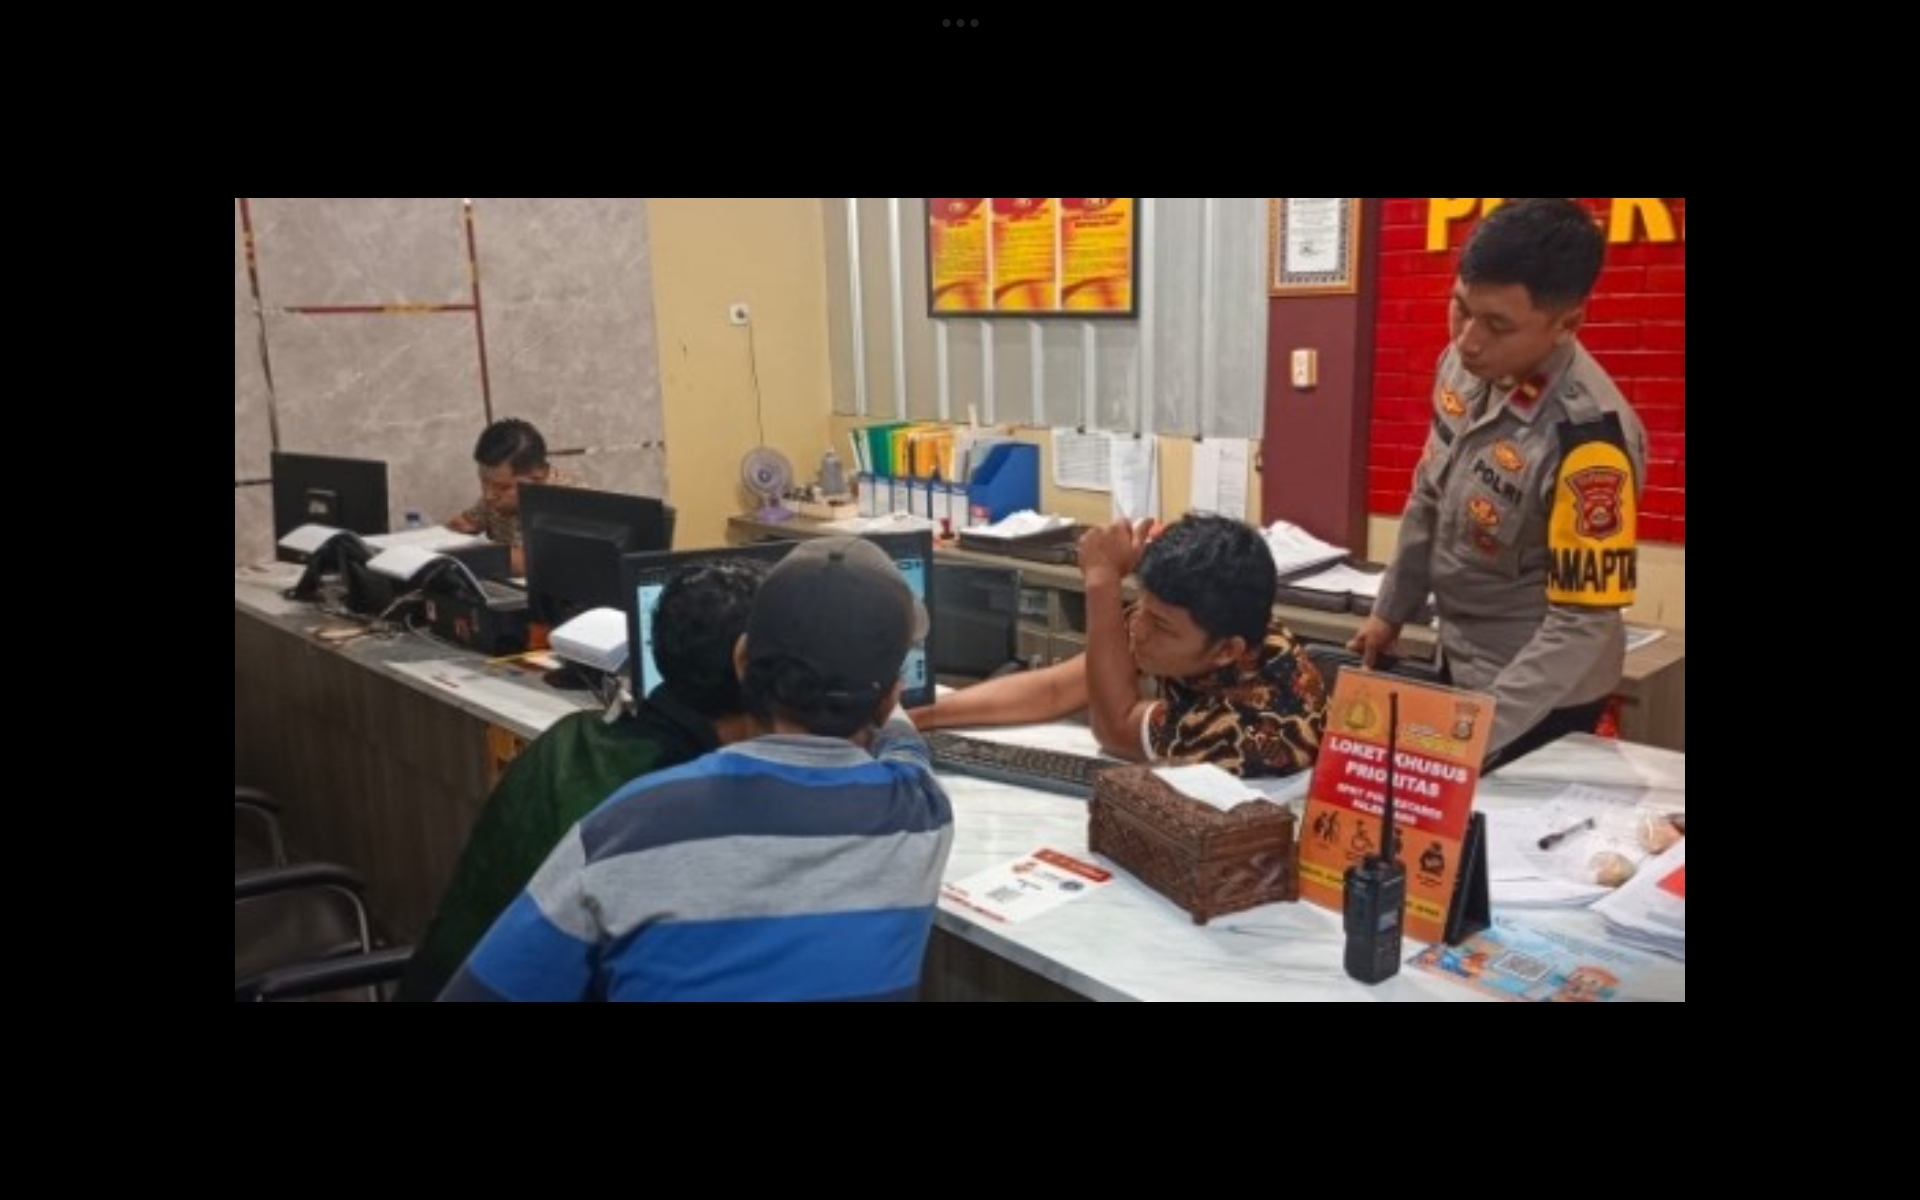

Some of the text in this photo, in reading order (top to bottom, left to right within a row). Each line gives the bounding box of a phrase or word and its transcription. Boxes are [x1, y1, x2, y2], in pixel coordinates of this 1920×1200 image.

[1474, 459, 1522, 506] POLRI
[1328, 736, 1387, 763] LOKET
[1393, 751, 1468, 784] KHUSUS
[1345, 760, 1441, 797] PRIOITAS
